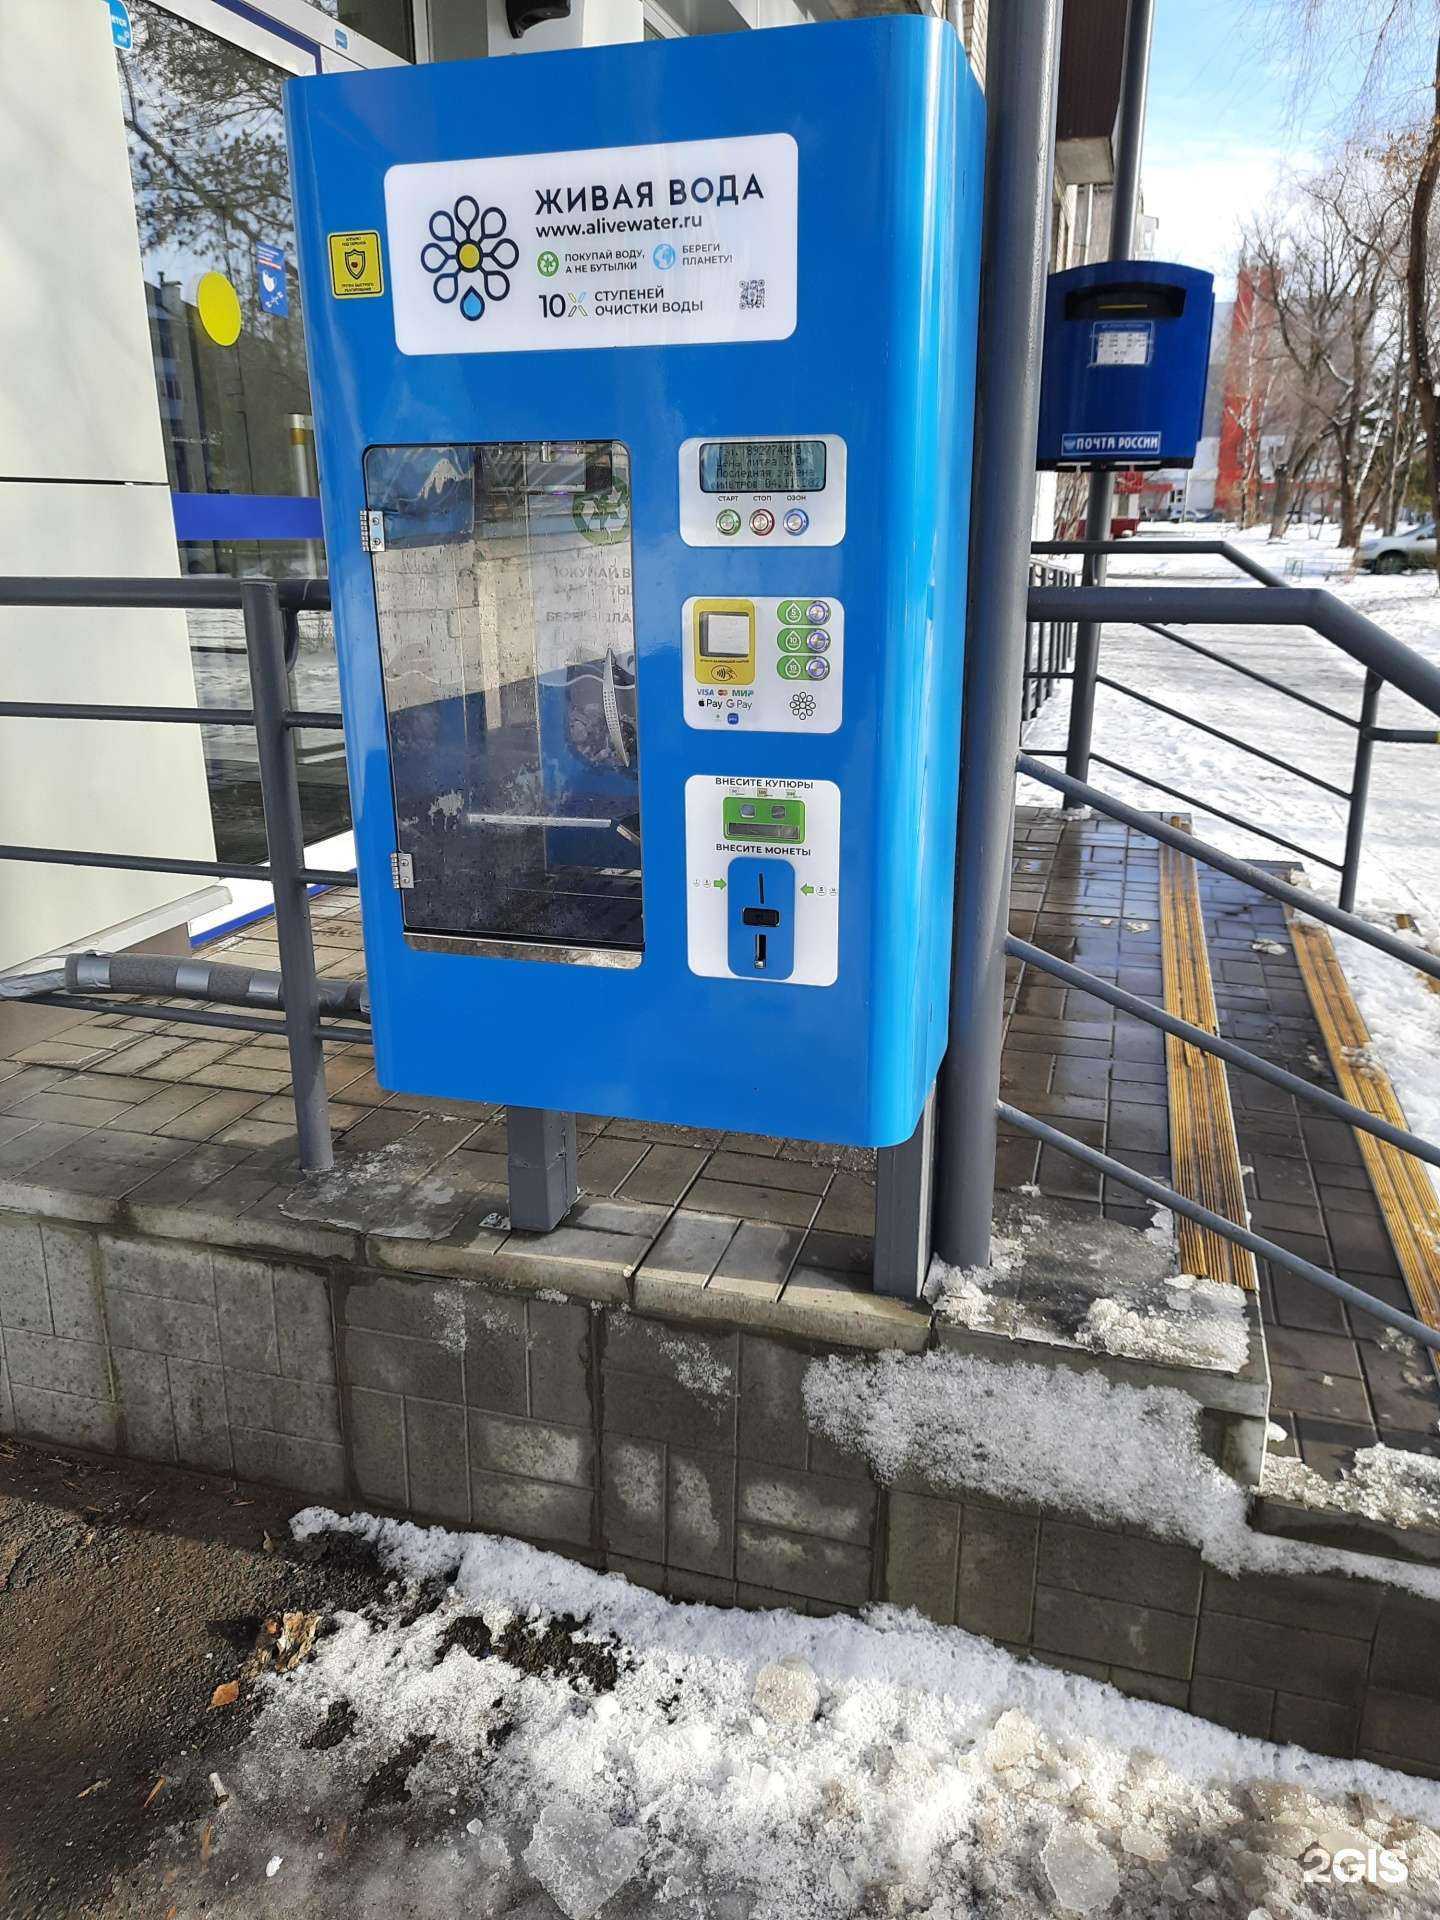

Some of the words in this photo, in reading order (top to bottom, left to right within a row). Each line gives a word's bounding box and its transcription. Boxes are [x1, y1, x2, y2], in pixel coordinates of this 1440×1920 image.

[535, 181, 653, 215] ЖИВАЯ
[669, 173, 764, 207] ВОДА
[535, 214, 703, 238] www.alivewater.ru
[682, 243, 720, 254] БЕРЕГИ
[565, 250, 613, 262] ПОКУПАЙ
[616, 249, 645, 259] ВОДУ,
[682, 254, 733, 266] ПЛАНЕТУ!
[565, 266, 572, 274] А
[575, 265, 588, 273] НЕ
[590, 262, 637, 273] БУТЫЛКИ
[594, 285, 664, 302] СТУПЕНЕЙ
[595, 302, 658, 317] ОЧИСТКИ
[662, 300, 703, 314] ВОДЫ
[1076, 436, 1115, 450] ПОЧТА
[1119, 435, 1158, 449] РОССИИ
[786, 494, 806, 502] ОЗОН
[696, 688, 715, 697] VISA
[732, 689, 754, 697] МИР
[706, 698, 723, 710] Pay
[737, 699, 753, 711] Pay
[715, 777, 763, 788] ВНЕСИТЕ
[765, 779, 814, 790] КУПЮРЫ
[715, 843, 763, 854] ВНЕСИТЕ
[765, 846, 811, 857] МОНЕТЫ
